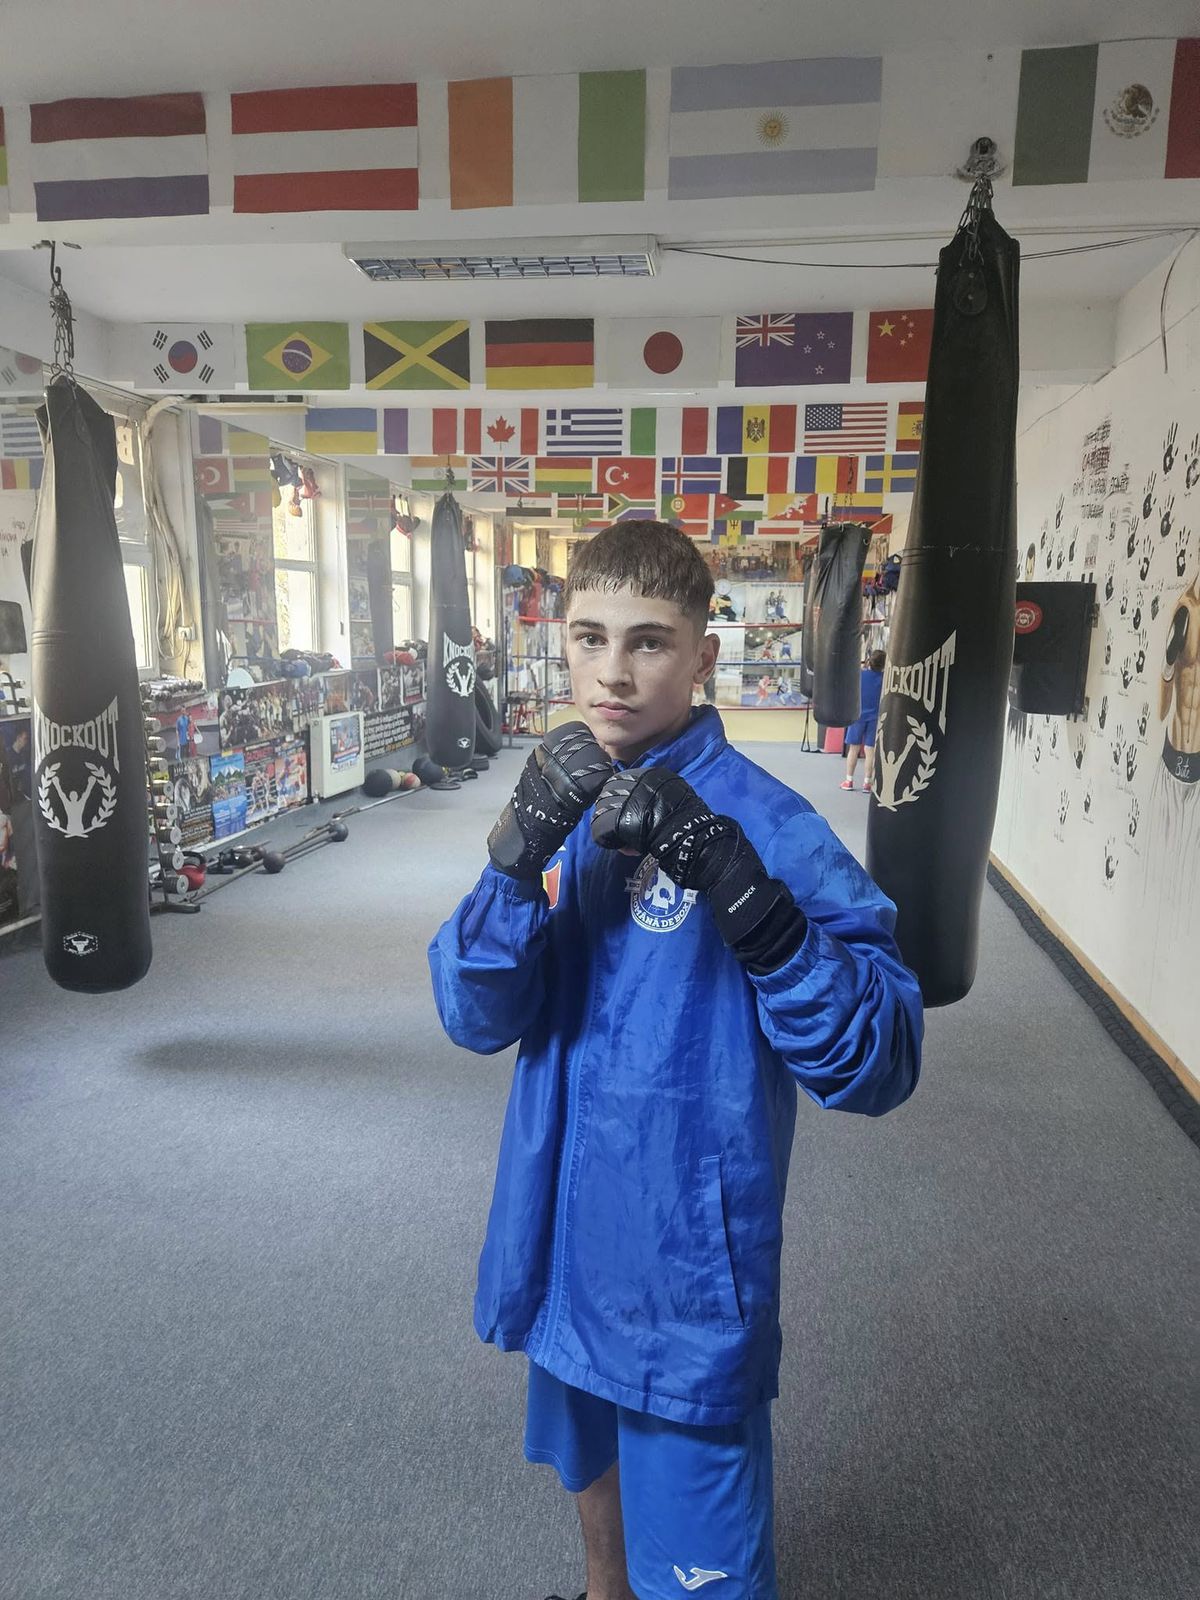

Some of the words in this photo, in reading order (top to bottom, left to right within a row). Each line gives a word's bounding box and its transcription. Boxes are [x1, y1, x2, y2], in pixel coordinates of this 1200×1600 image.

[443, 631, 477, 669] KNOCKO
[884, 629, 957, 736] OCKOUT
[33, 695, 120, 774] KNOCKOUT
[661, 919, 675, 928] DE
[674, 902, 690, 922] BOX
[727, 885, 756, 914] OUTSHOCK
